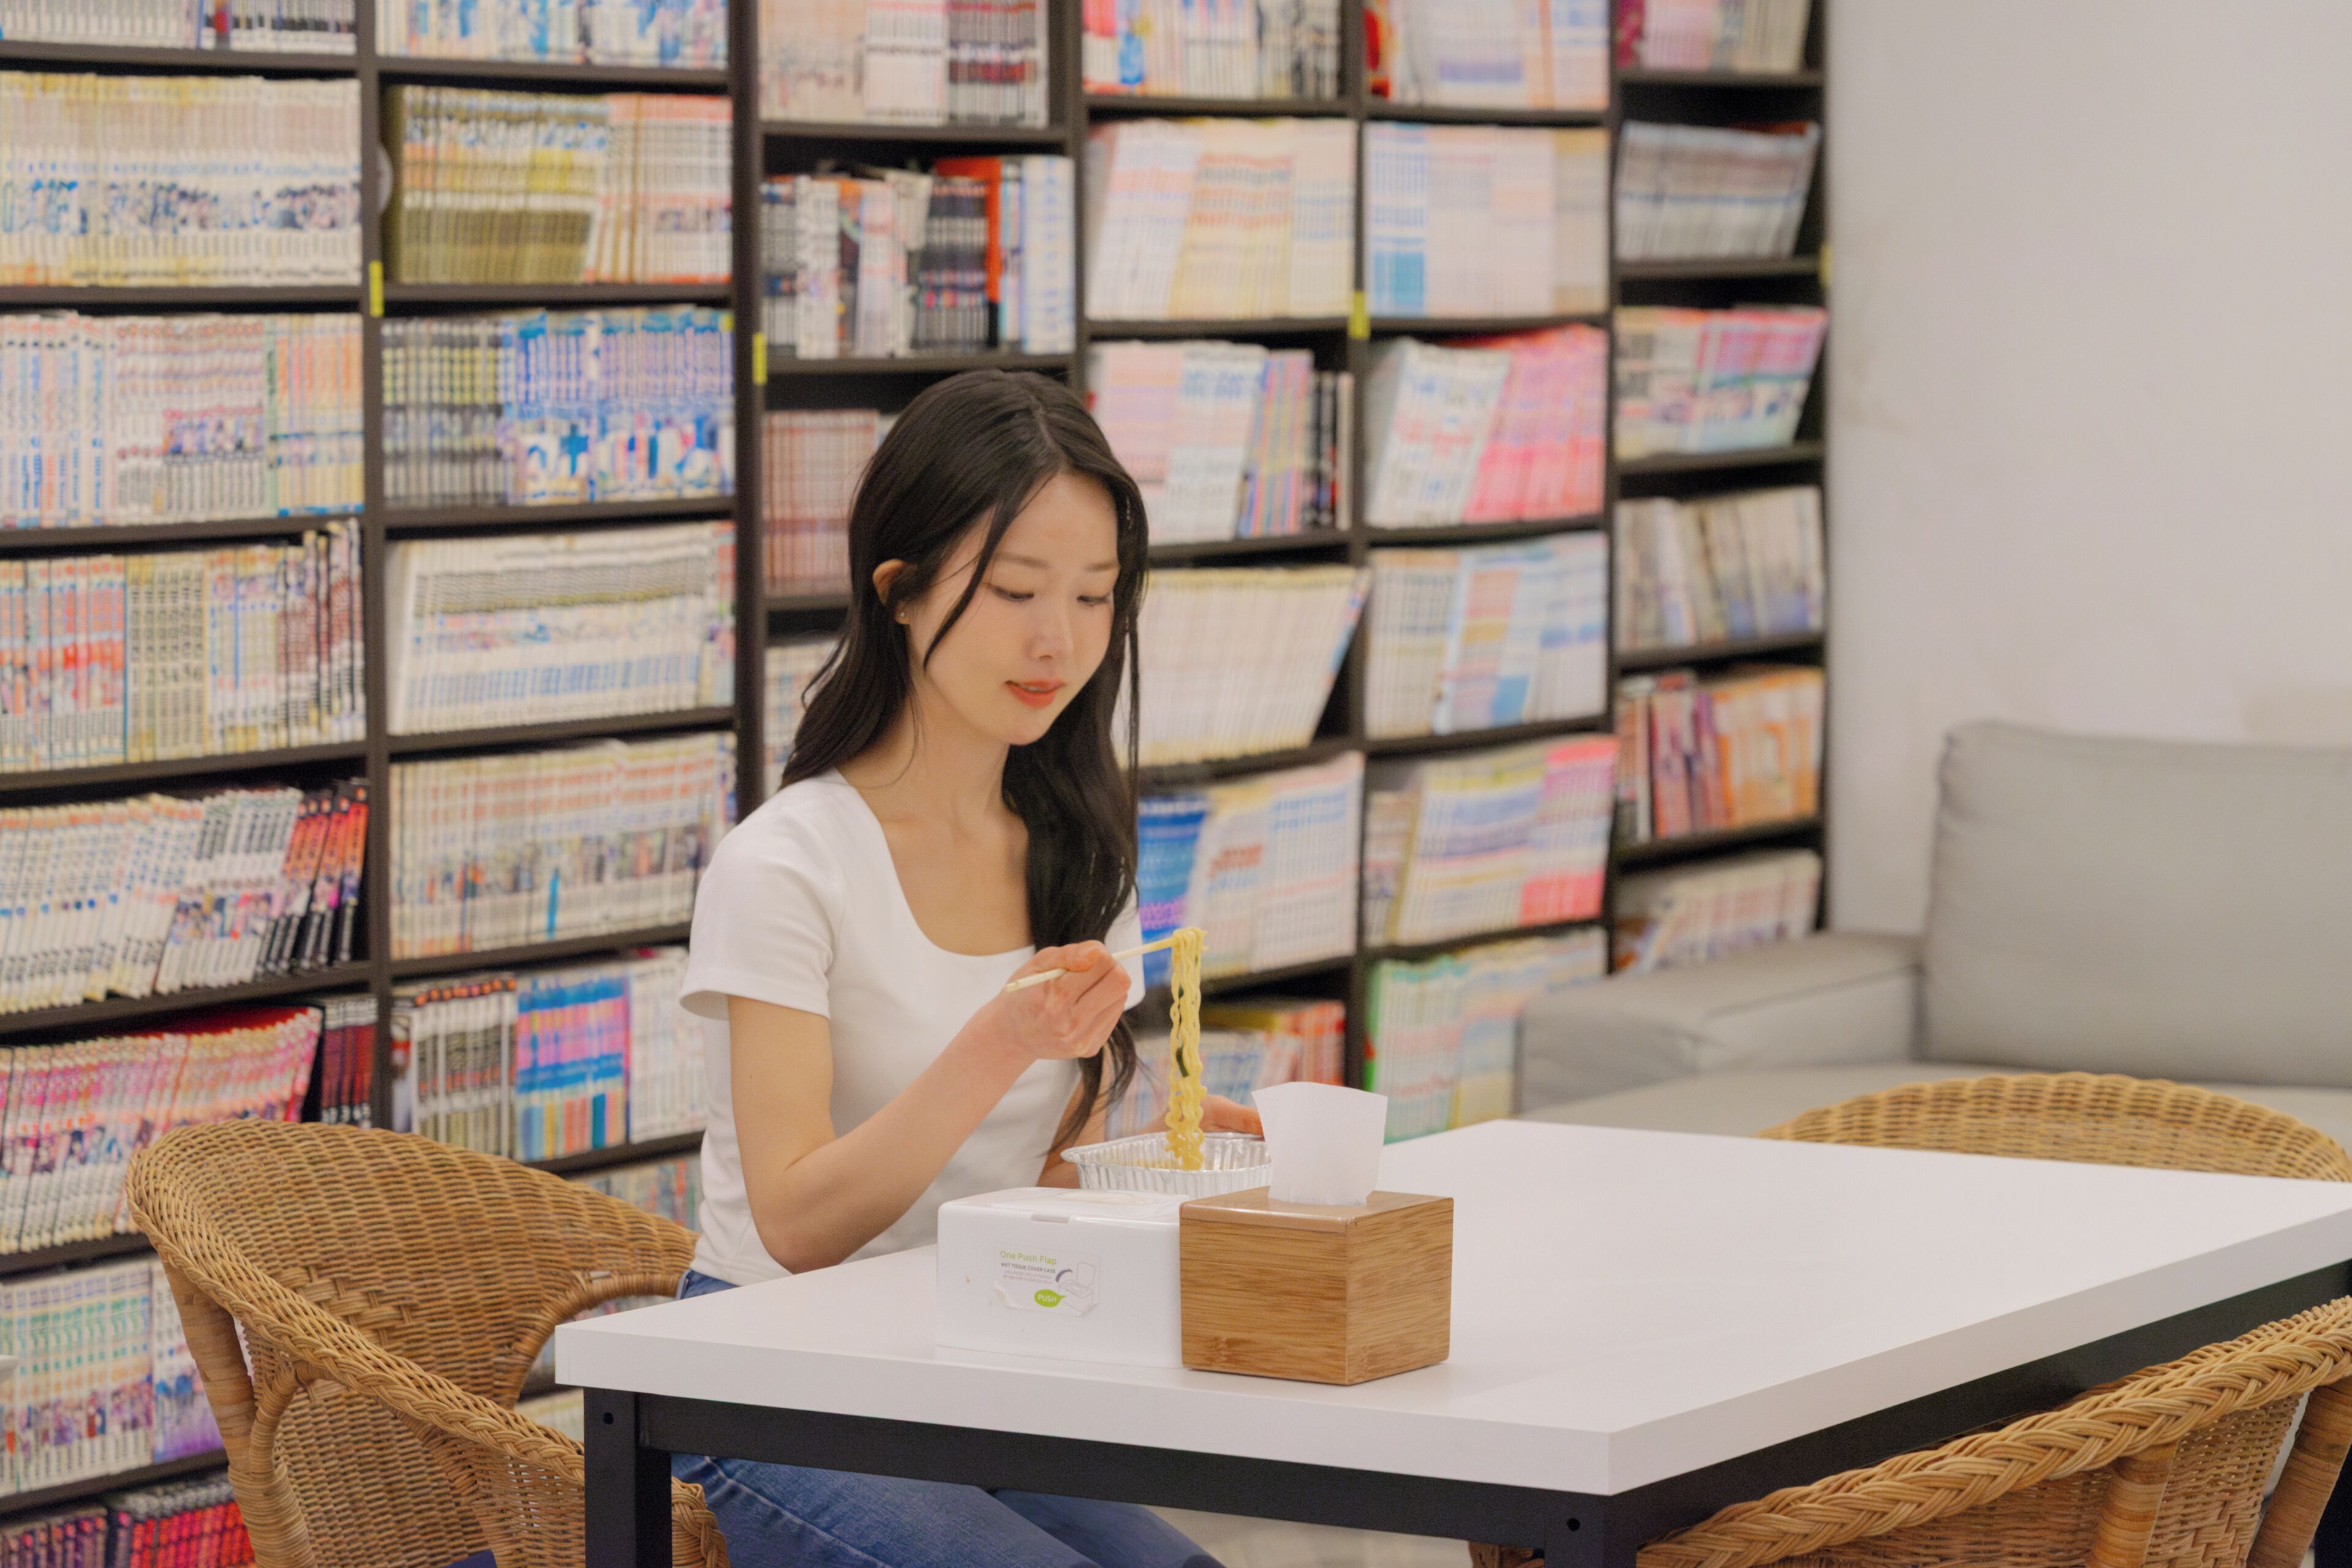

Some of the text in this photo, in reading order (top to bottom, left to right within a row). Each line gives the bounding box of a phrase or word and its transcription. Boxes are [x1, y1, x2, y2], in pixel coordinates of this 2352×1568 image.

[1000, 1250, 1057, 1265] One Push Flap
[1038, 1293, 1057, 1303] PUSH
